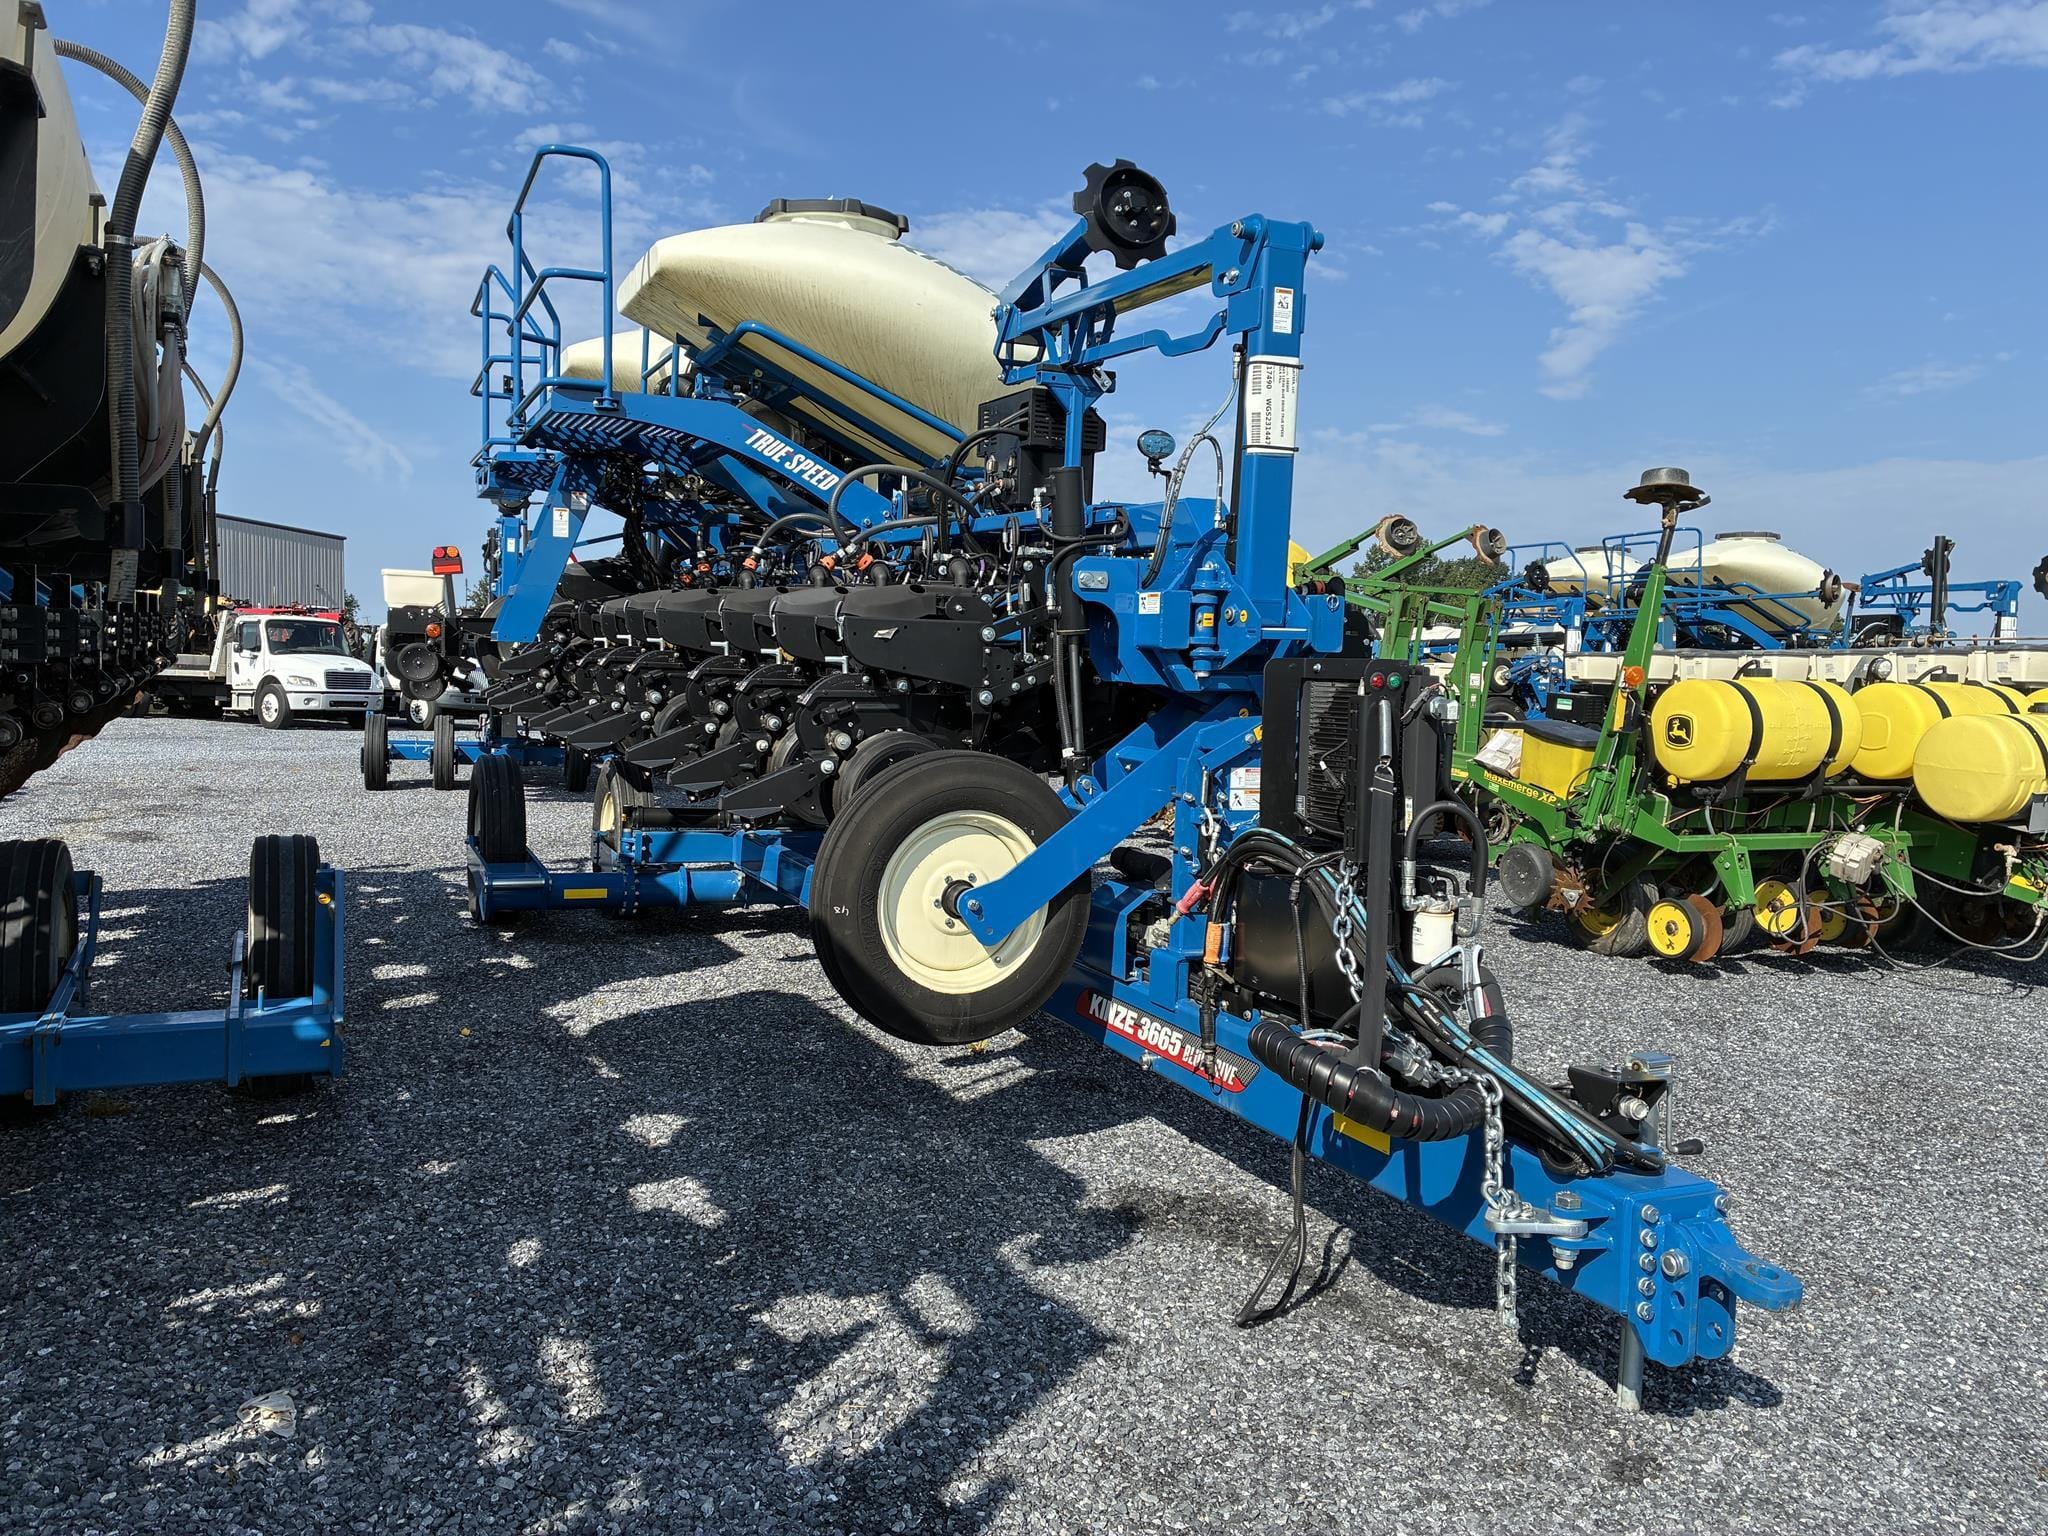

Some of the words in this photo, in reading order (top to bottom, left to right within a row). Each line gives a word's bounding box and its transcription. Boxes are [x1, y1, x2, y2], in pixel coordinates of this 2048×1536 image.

[744, 428, 794, 463] TRUE
[784, 454, 840, 491] SPEED
[1483, 769, 1539, 798] MaxEmerge
[1538, 791, 1557, 802] XP
[1089, 993, 1139, 1035] KINZE
[1137, 1016, 1183, 1056] 3665
[1214, 1058, 1238, 1086] RIVE
